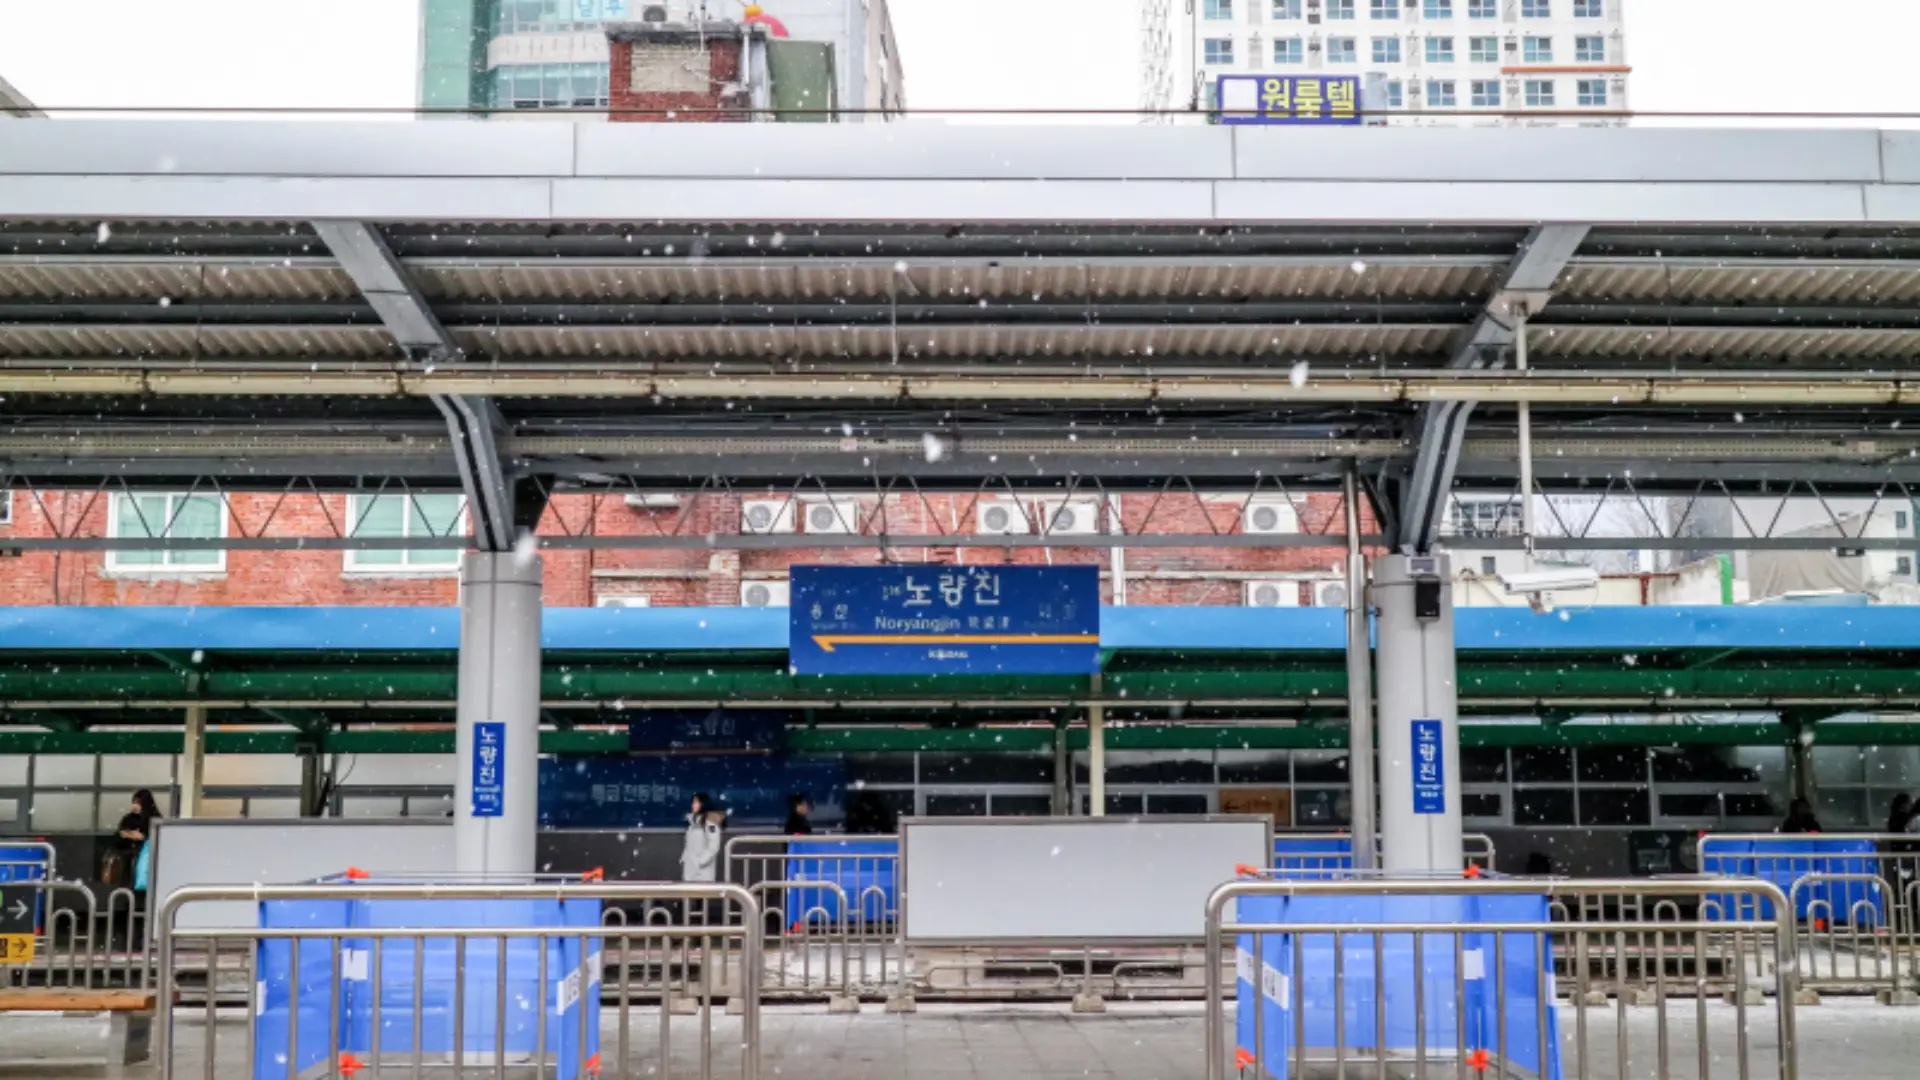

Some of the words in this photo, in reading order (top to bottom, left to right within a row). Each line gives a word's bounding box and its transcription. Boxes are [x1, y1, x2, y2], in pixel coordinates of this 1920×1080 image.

[904, 573, 1001, 607] 노량진
[479, 726, 498, 785] 노량진
[1418, 724, 1437, 782] 노량진
